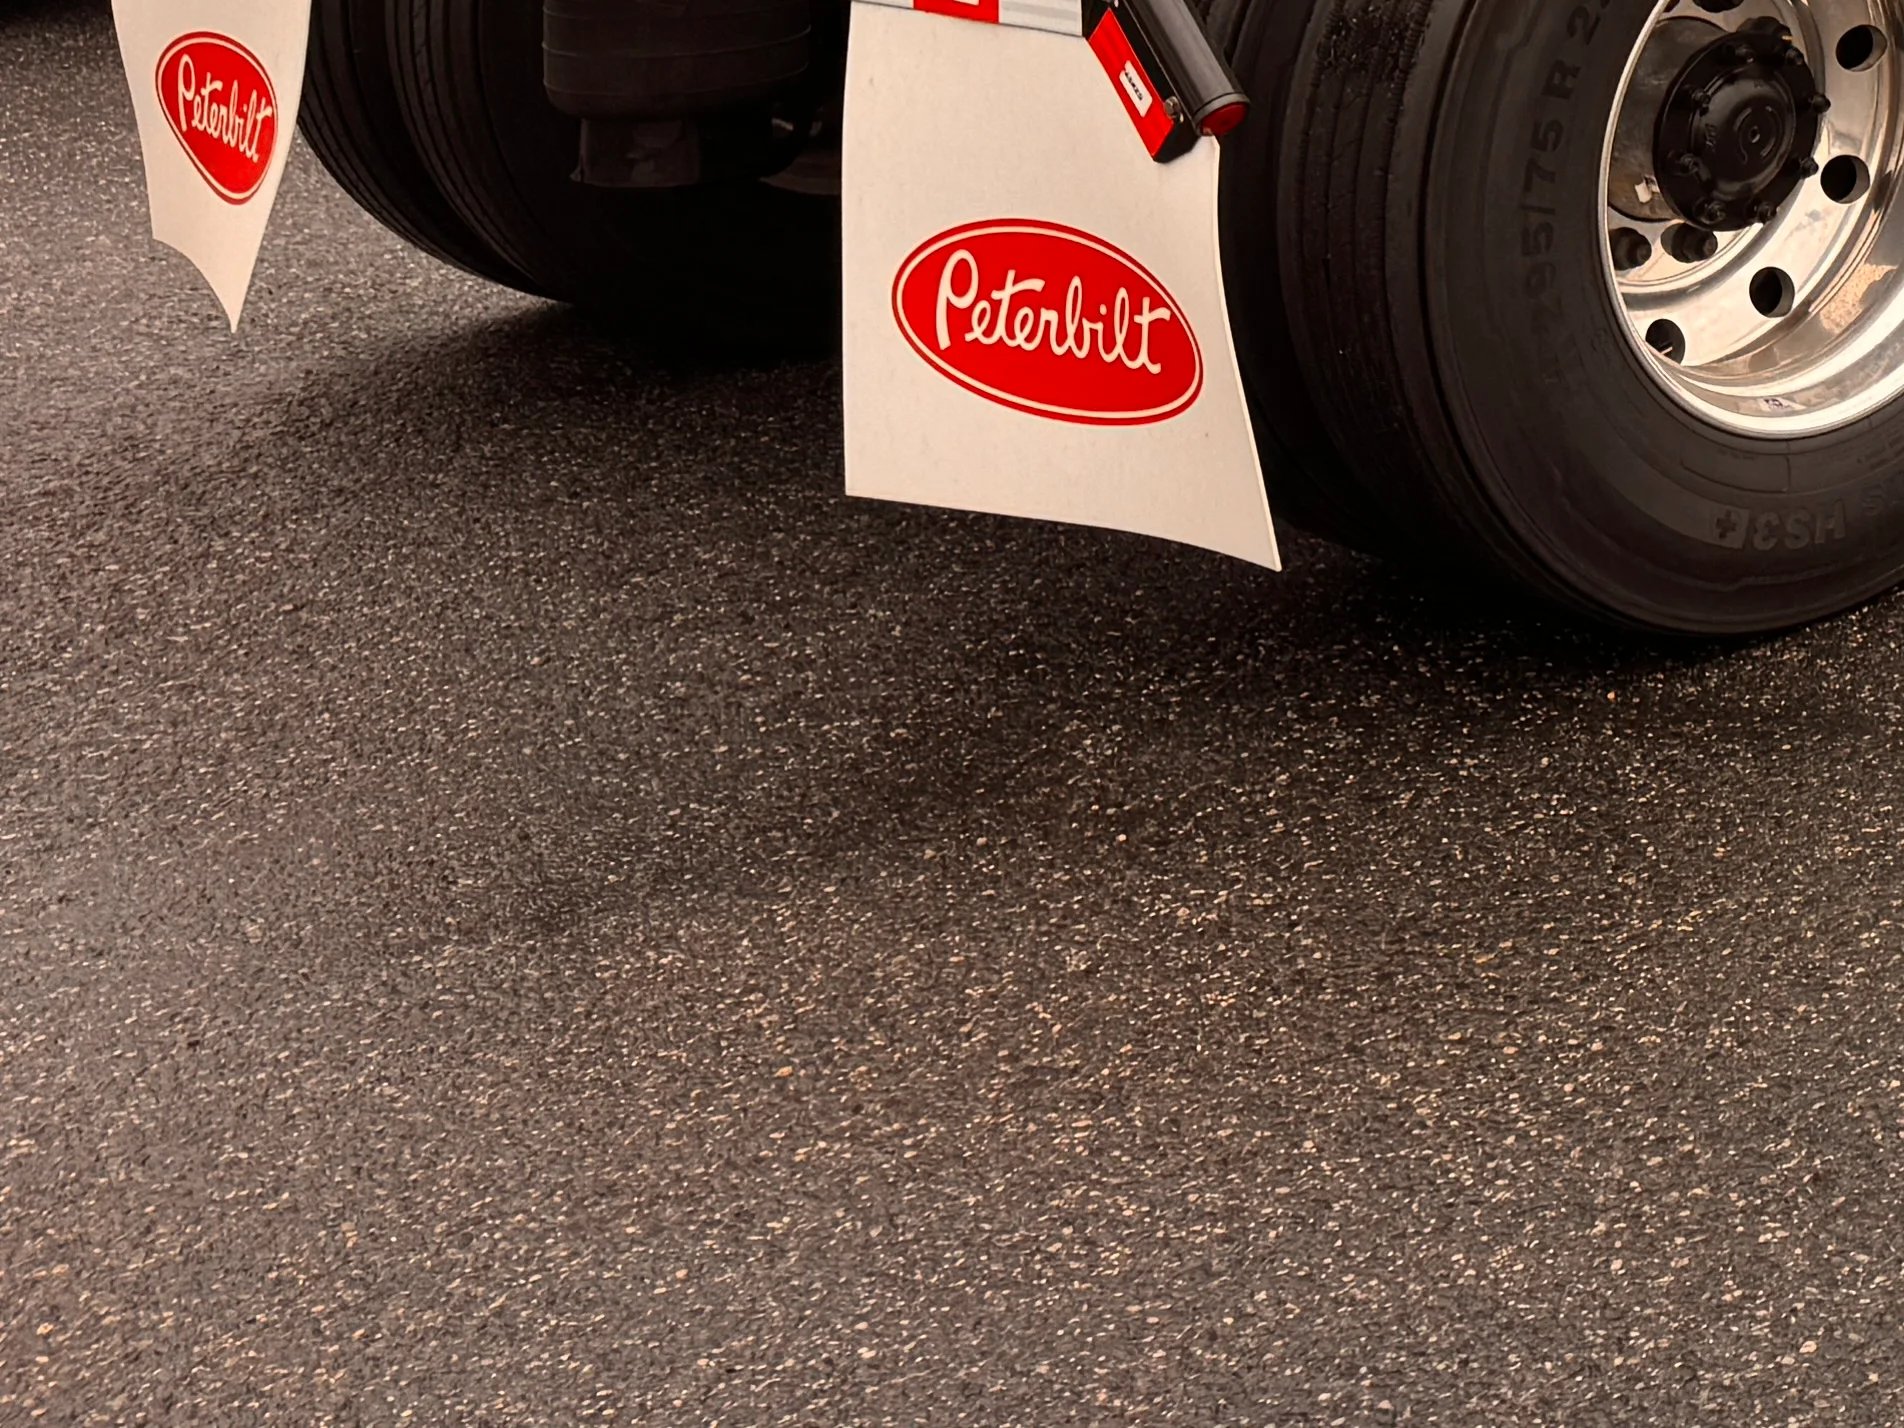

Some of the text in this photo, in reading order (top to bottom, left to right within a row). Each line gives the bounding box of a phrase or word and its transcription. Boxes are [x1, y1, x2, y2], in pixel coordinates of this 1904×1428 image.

[177, 54, 273, 164] Peterbilt
[1539, 61, 1583, 101] R
[936, 249, 1171, 374] Peterbilt
